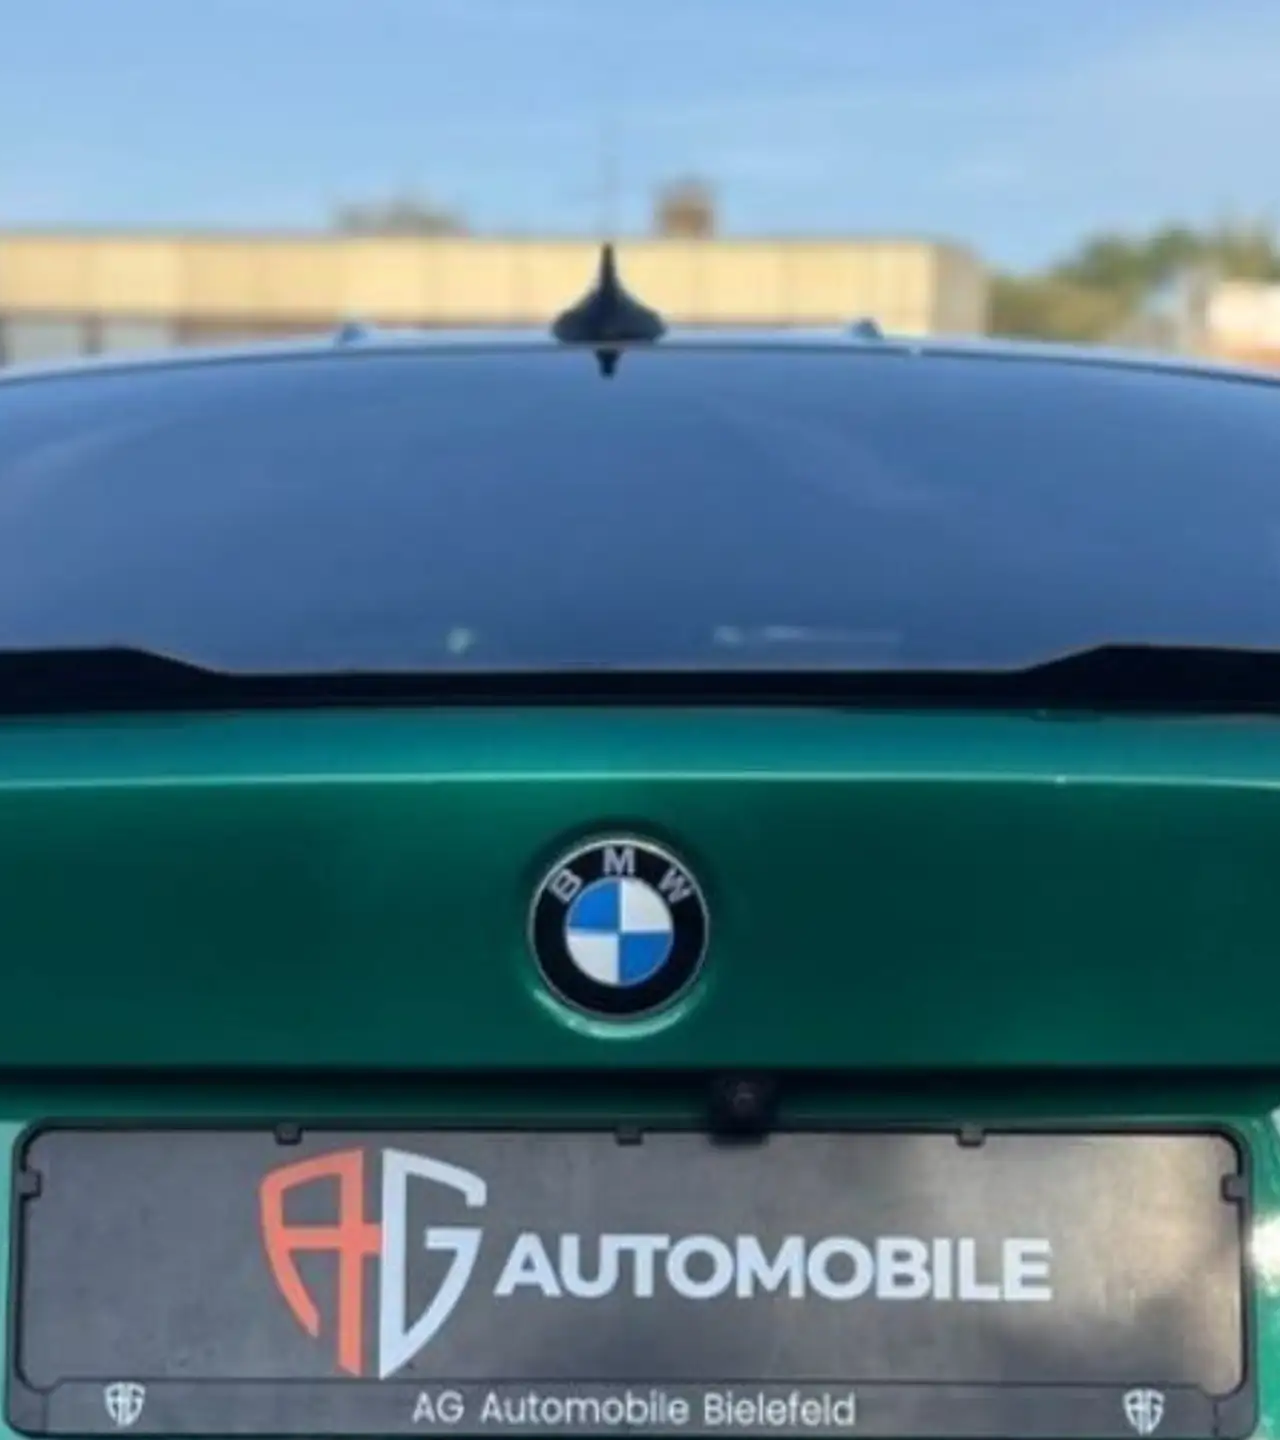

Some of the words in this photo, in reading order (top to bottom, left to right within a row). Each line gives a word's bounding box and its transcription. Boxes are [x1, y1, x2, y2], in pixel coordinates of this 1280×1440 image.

[549, 844, 695, 904] BMW
[493, 1234, 1053, 1302] AUTOMOBILE
[411, 1388, 465, 1425] AG
[479, 1388, 691, 1427] Automobile
[703, 1389, 856, 1429] Bielefeld
